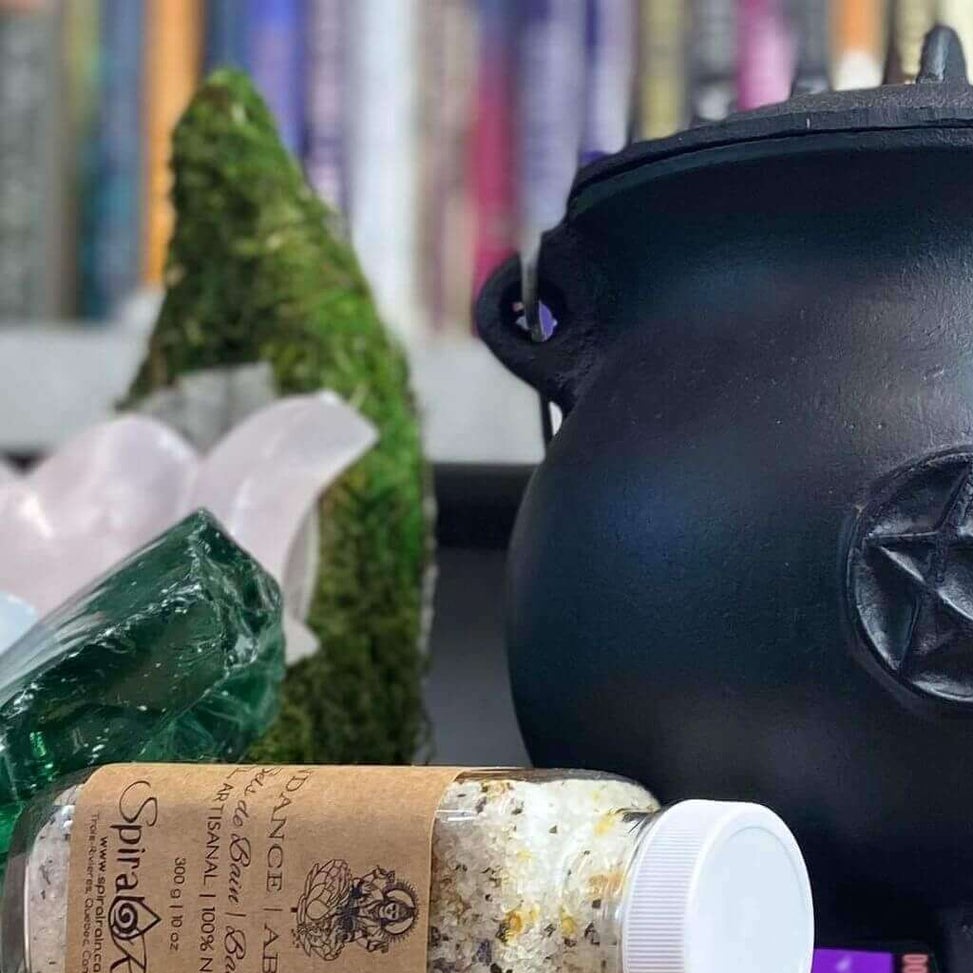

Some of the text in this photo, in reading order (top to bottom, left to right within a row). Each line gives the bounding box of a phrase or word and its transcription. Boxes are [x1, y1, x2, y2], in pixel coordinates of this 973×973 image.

[109, 780, 158, 904] Spiral
[204, 782, 234, 886] ARTISANAL
[174, 857, 187, 884] 300
[227, 834, 251, 905] Bain
[168, 932, 180, 951] oz
[169, 915, 183, 928] 10
[200, 906, 216, 951] 100%
